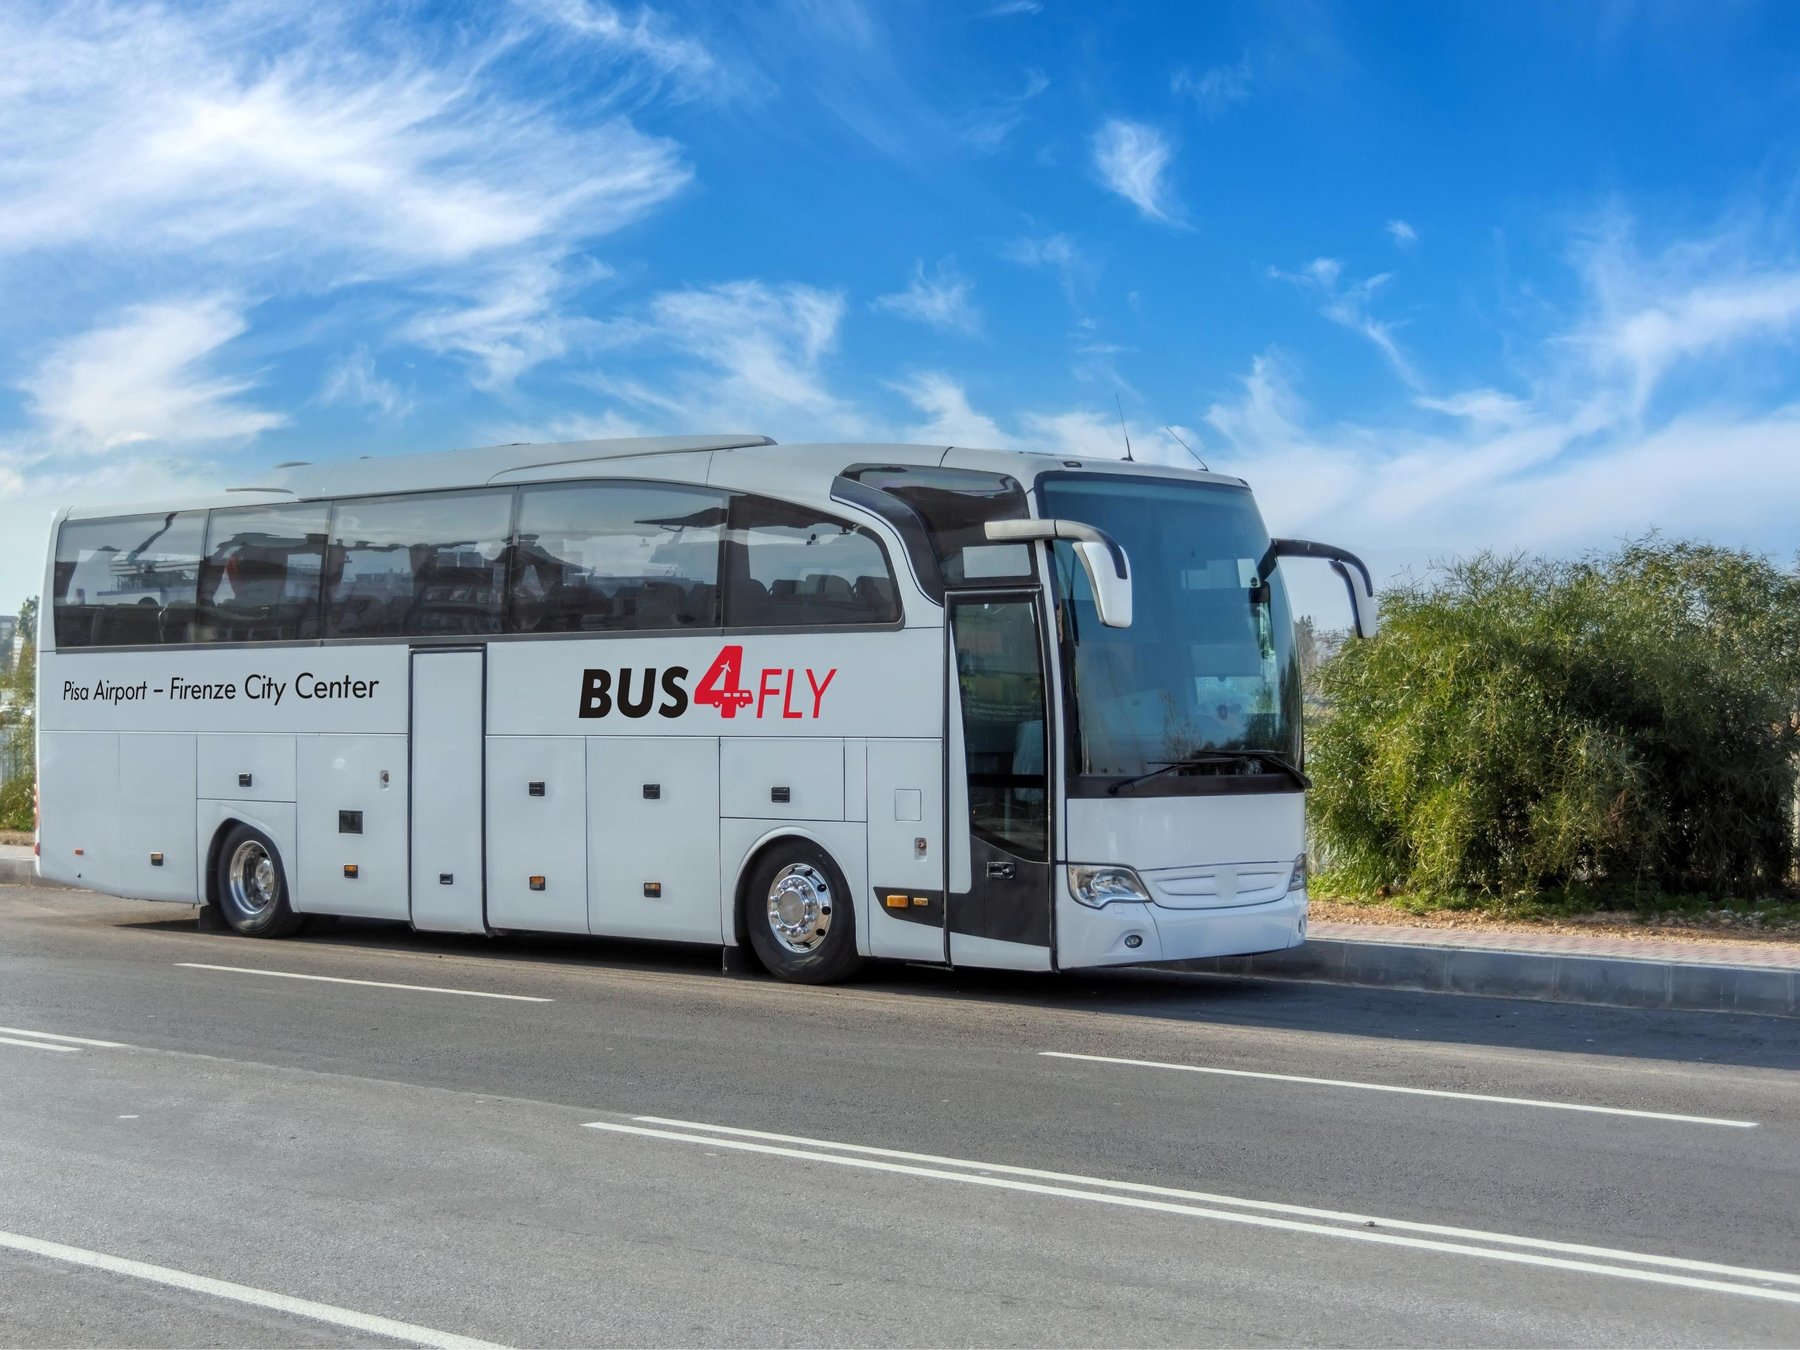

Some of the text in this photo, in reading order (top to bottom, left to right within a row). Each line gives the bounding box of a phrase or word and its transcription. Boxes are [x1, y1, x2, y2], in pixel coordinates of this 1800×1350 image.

[63, 680, 90, 701] Pisa
[92, 679, 148, 706] Airport
[169, 676, 237, 700] Firenze
[244, 672, 285, 706] City
[294, 671, 380, 700] Center
